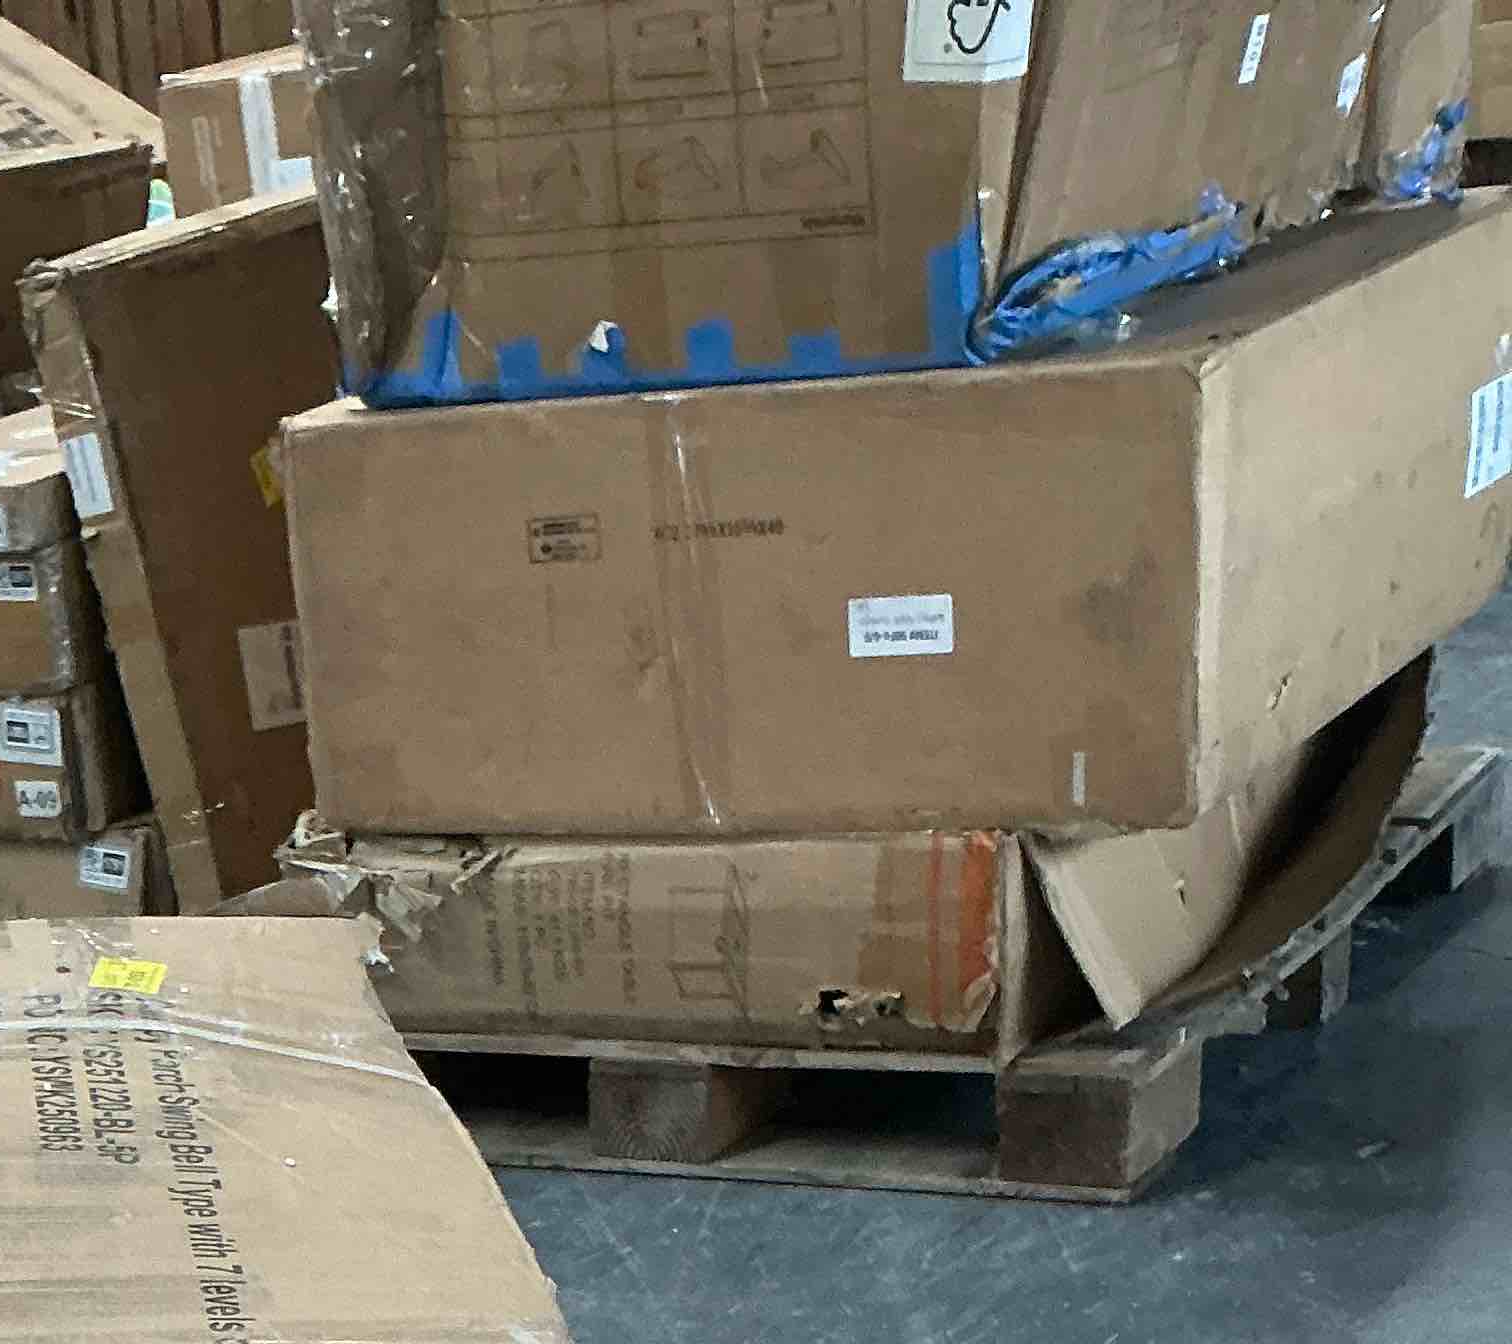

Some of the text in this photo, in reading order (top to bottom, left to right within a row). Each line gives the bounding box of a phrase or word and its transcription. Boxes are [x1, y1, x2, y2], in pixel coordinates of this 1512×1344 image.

[170, 1143, 219, 1173] Bell
[168, 1177, 222, 1218] Type
[188, 1223, 238, 1258] with
[196, 1264, 244, 1275] 7
[200, 1280, 256, 1332] levels
